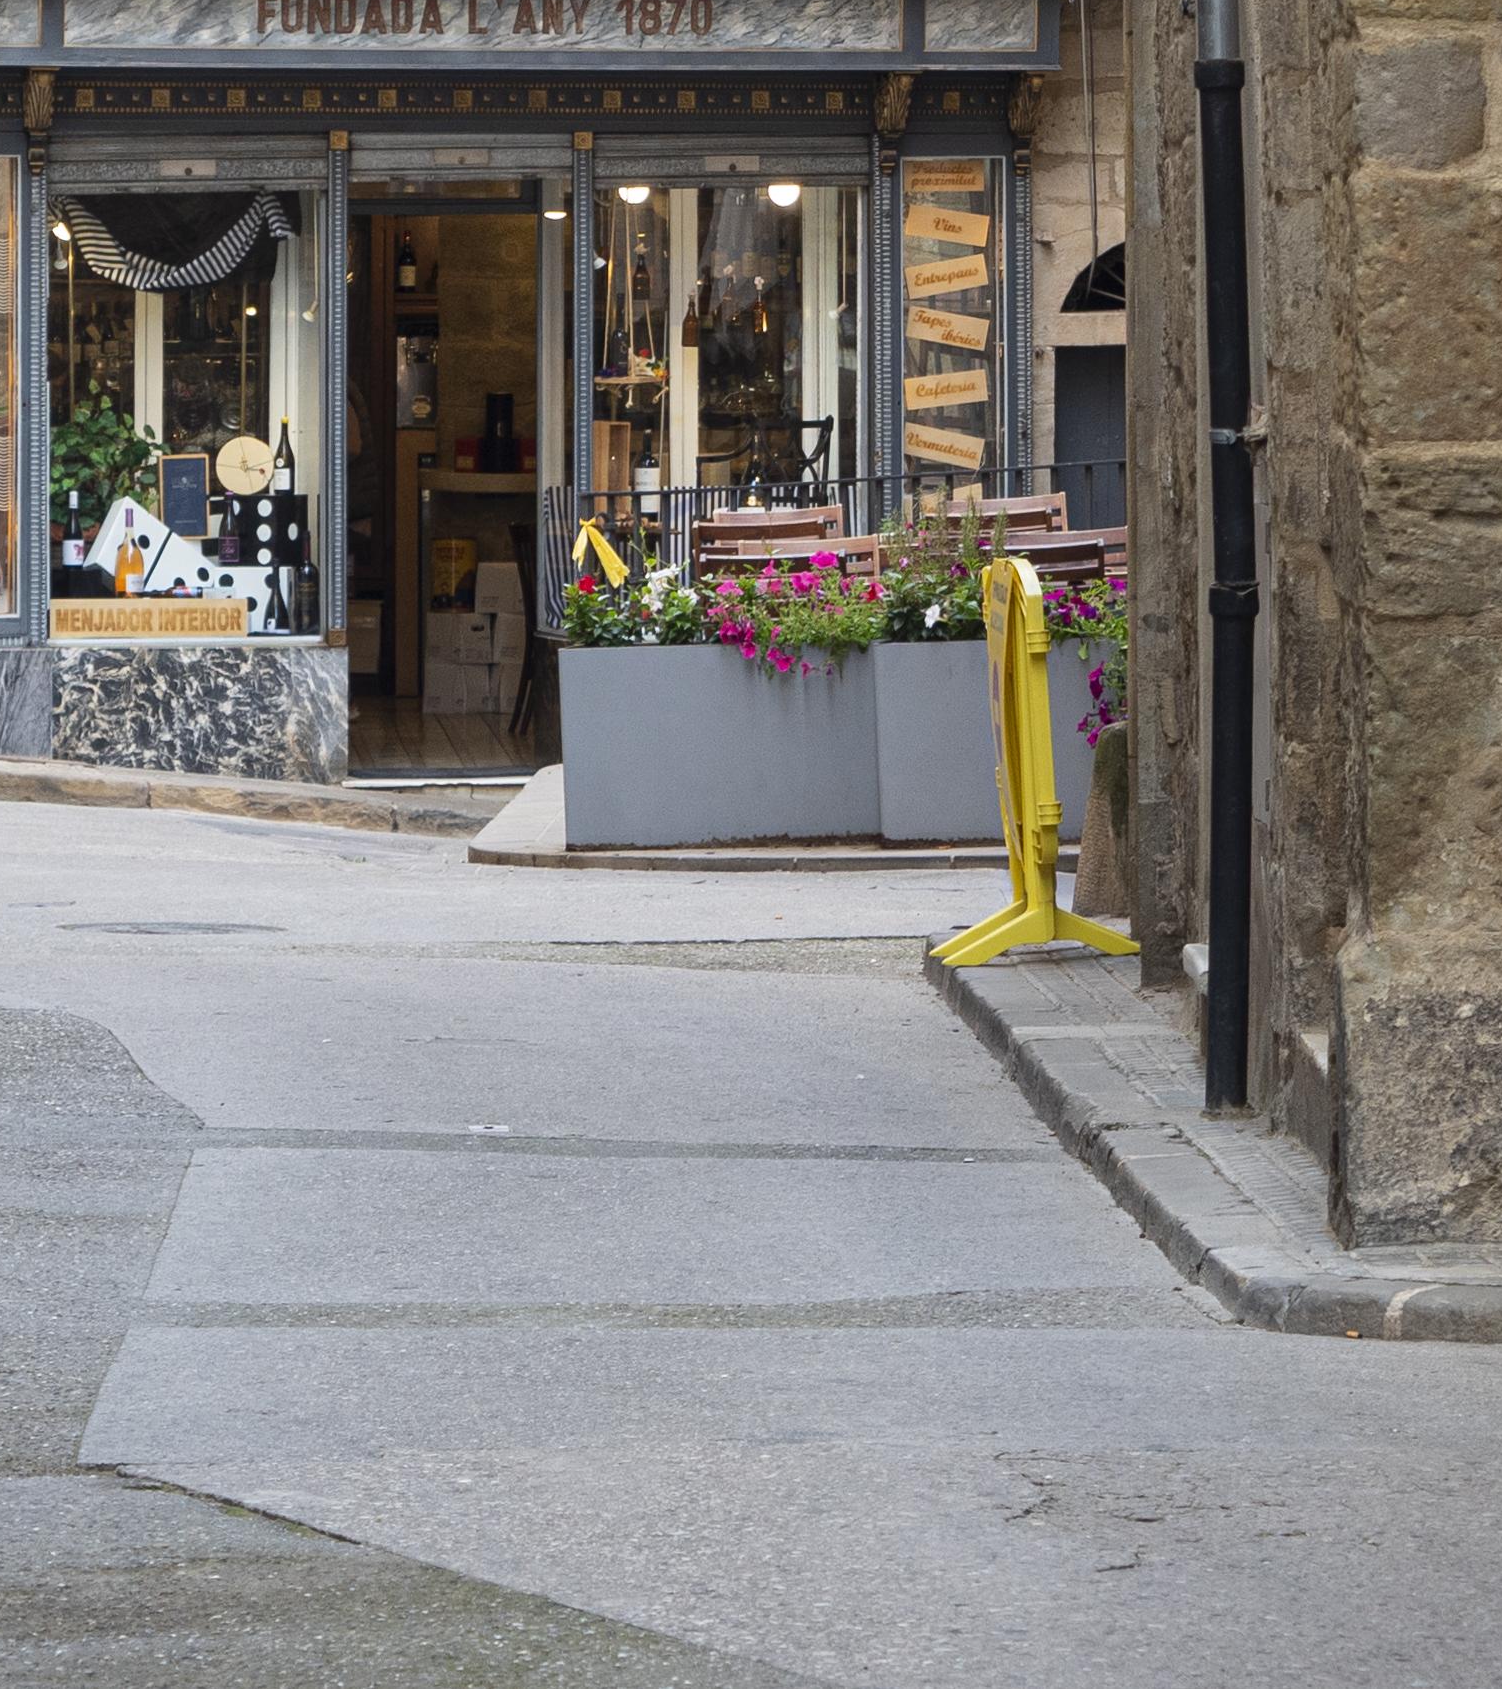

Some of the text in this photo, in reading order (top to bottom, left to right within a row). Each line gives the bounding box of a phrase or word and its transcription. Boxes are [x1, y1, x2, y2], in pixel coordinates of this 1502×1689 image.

[933, 217, 963, 234] Vins
[914, 265, 980, 287] Entrepans
[912, 309, 952, 329] Tapes
[915, 381, 977, 399] Cafeteria
[906, 432, 979, 459] Vermuteria
[55, 607, 242, 632] MENJADOR INTERIOR
